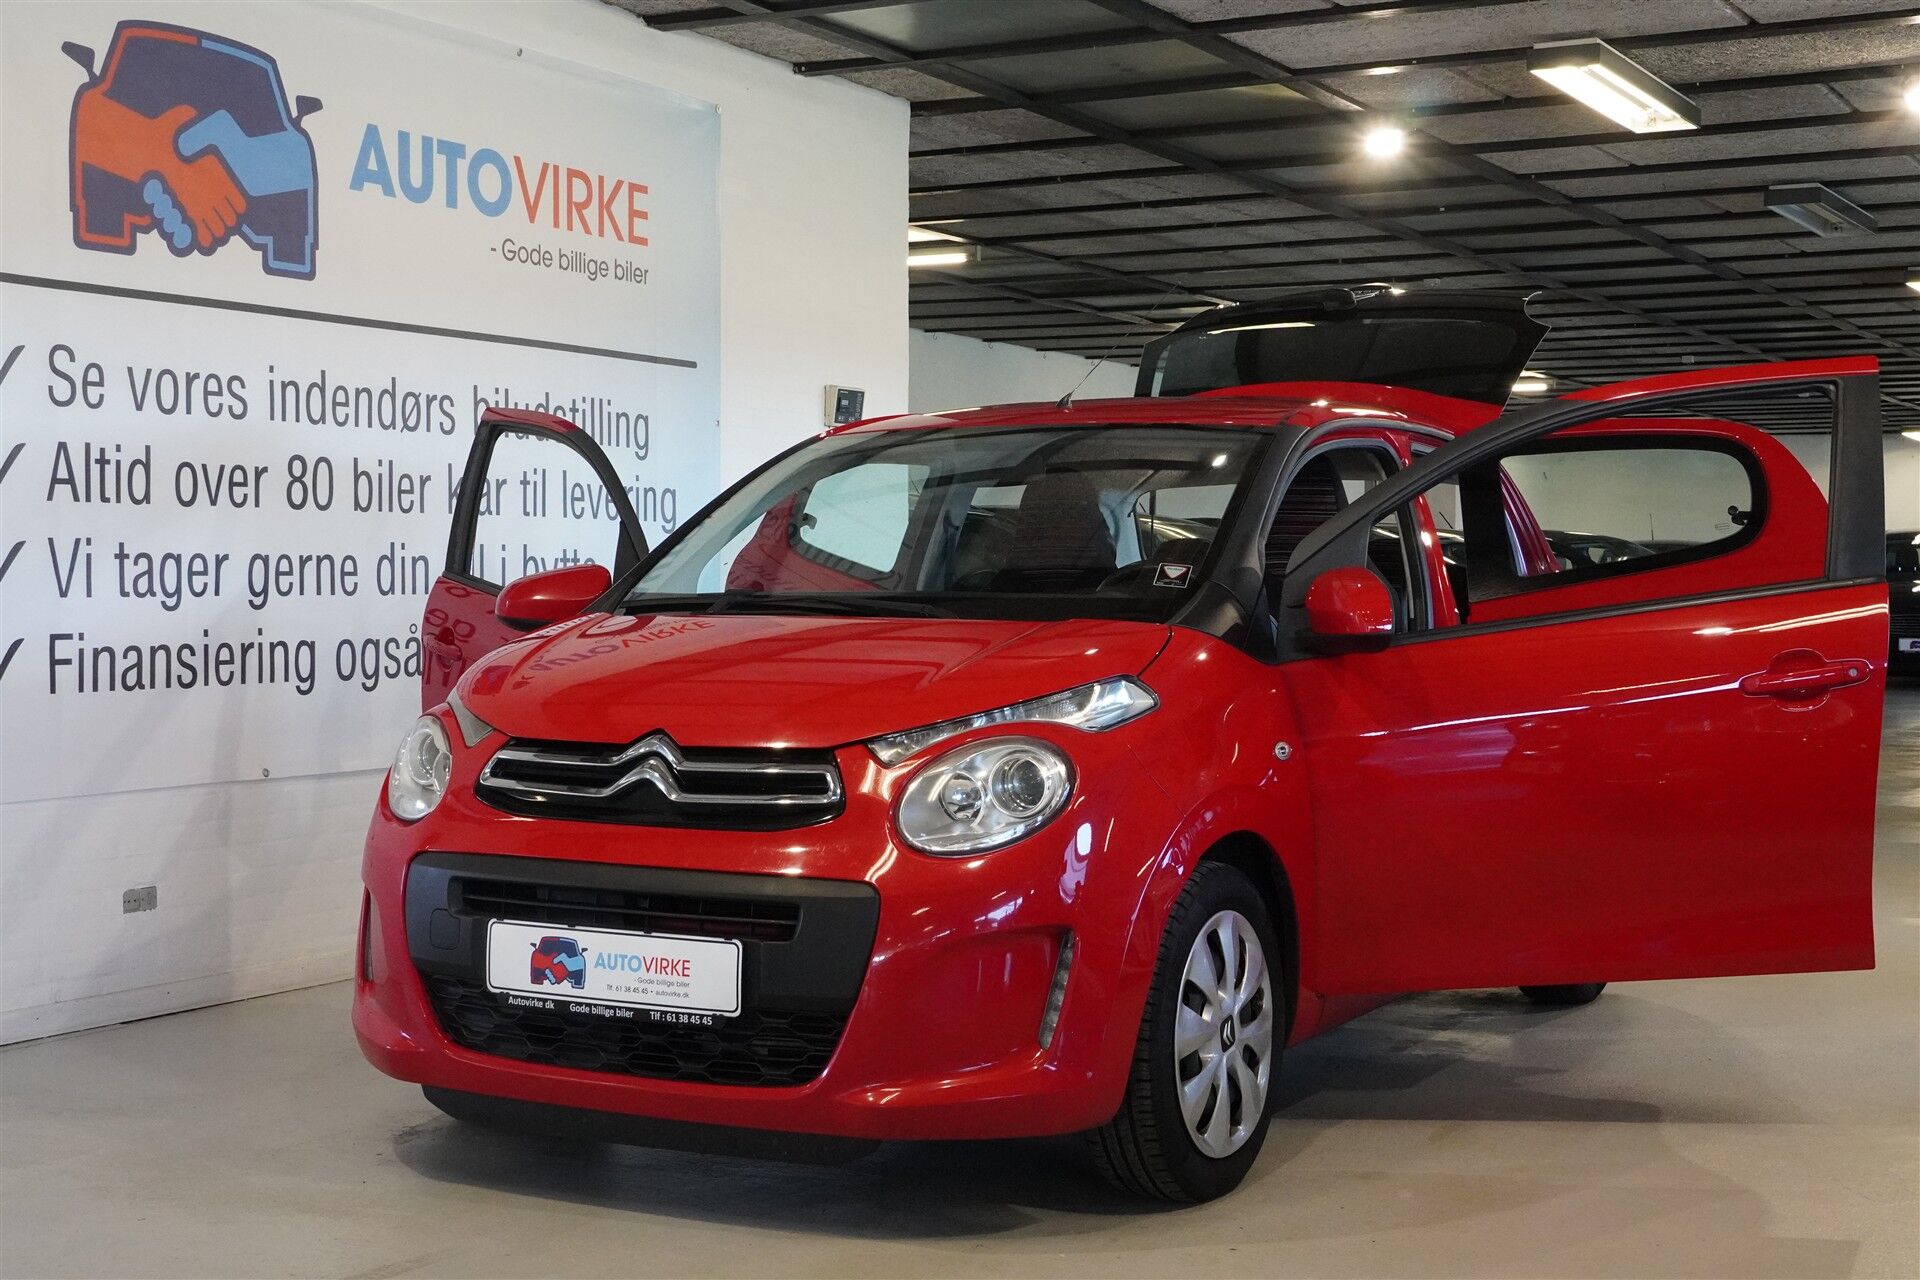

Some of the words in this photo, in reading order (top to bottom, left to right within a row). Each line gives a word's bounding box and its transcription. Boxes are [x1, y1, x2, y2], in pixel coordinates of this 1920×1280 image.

[350, 123, 649, 247] AUTOVIRKE
[501, 238, 553, 268] Gode
[558, 248, 609, 282] billige
[614, 258, 649, 285] biler
[47, 343, 106, 411] Se
[126, 365, 249, 420] vores
[268, 366, 456, 434] indendørs
[473, 385, 650, 461] bldtilling
[47, 440, 152, 505] Altid
[175, 462, 269, 509] over
[286, 454, 335, 513] 80
[352, 457, 432, 514] biler
[448, 463, 508, 516] kar
[519, 468, 547, 518] til
[47, 537, 92, 599] Vi
[114, 541, 230, 612] tager
[247, 552, 368, 611] gerne
[375, 540, 430, 596] din
[49, 627, 316, 697] Finansiering
[335, 624, 423, 693] også
[594, 952, 691, 977] AUTOVIRKE
[637, 977, 655, 985] Gode
[656, 979, 675, 988] billige
[508, 996, 543, 1008] Autovirke
[545, 1000, 555, 1009] dk
[615, 984, 622, 992] 61
[624, 985, 631, 993] 38
[632, 986, 640, 994] 45
[641, 987, 648, 995] 45
[569, 1003, 590, 1014] Gode
[591, 1005, 614, 1018] billige
[616, 1008, 634, 1018] biler
[667, 1012, 677, 1022] 61
[678, 1013, 689, 1023] 38
[690, 1014, 700, 1024] 45
[702, 1015, 713, 1026] 45
